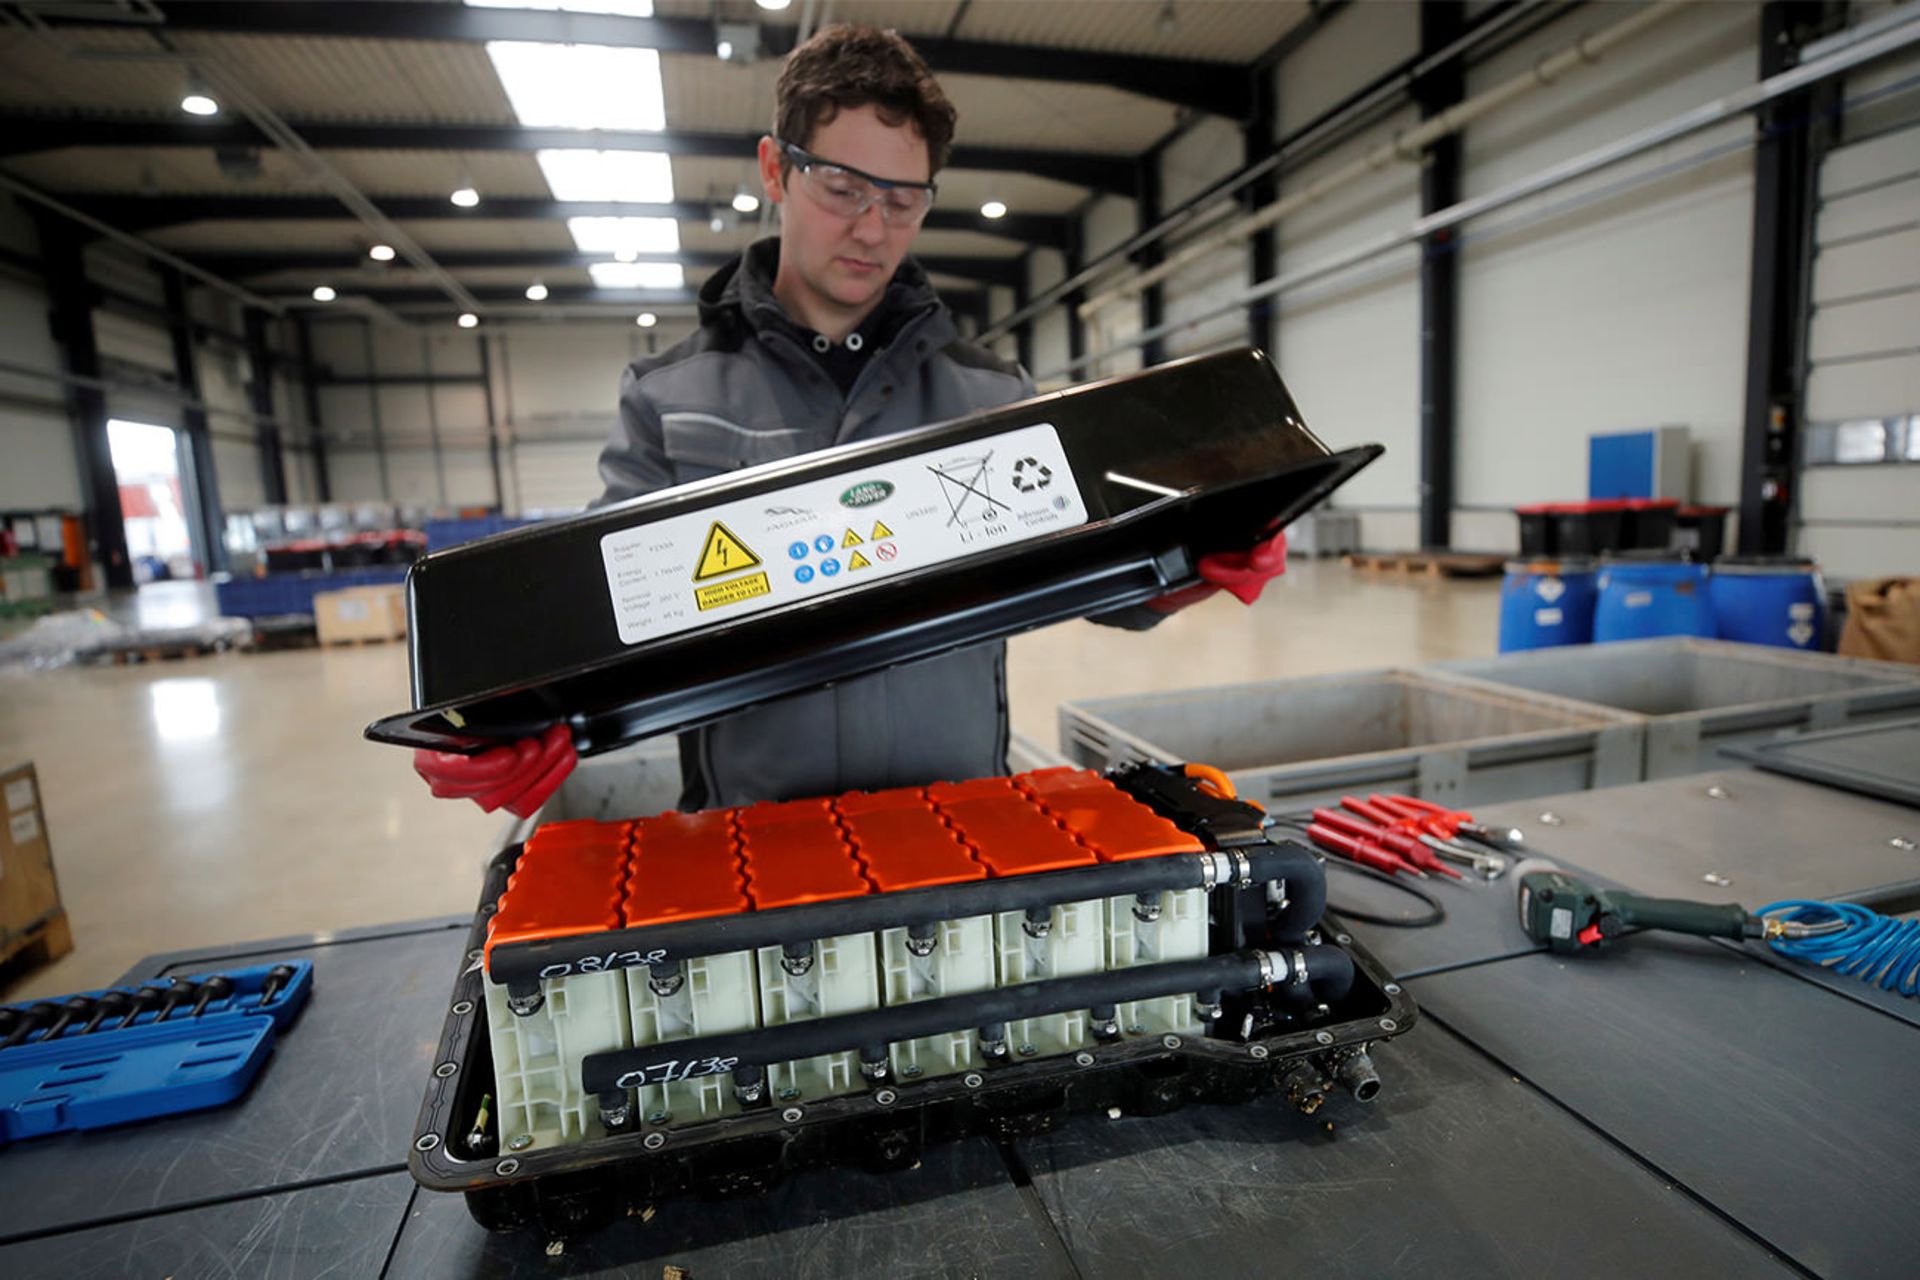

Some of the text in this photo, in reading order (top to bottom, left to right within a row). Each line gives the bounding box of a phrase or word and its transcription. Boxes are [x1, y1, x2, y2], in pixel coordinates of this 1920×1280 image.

[850, 484, 879, 497] LAND
[853, 488, 886, 504] ROVER
[959, 530, 975, 544] Li
[983, 523, 1008, 538] Ion
[702, 592, 735, 606] DANGER
[747, 584, 764, 596] LIFE
[704, 577, 758, 597] HIGH VOLTAGE
[540, 948, 667, 980] 08/38
[616, 1056, 739, 1089] 07/38
